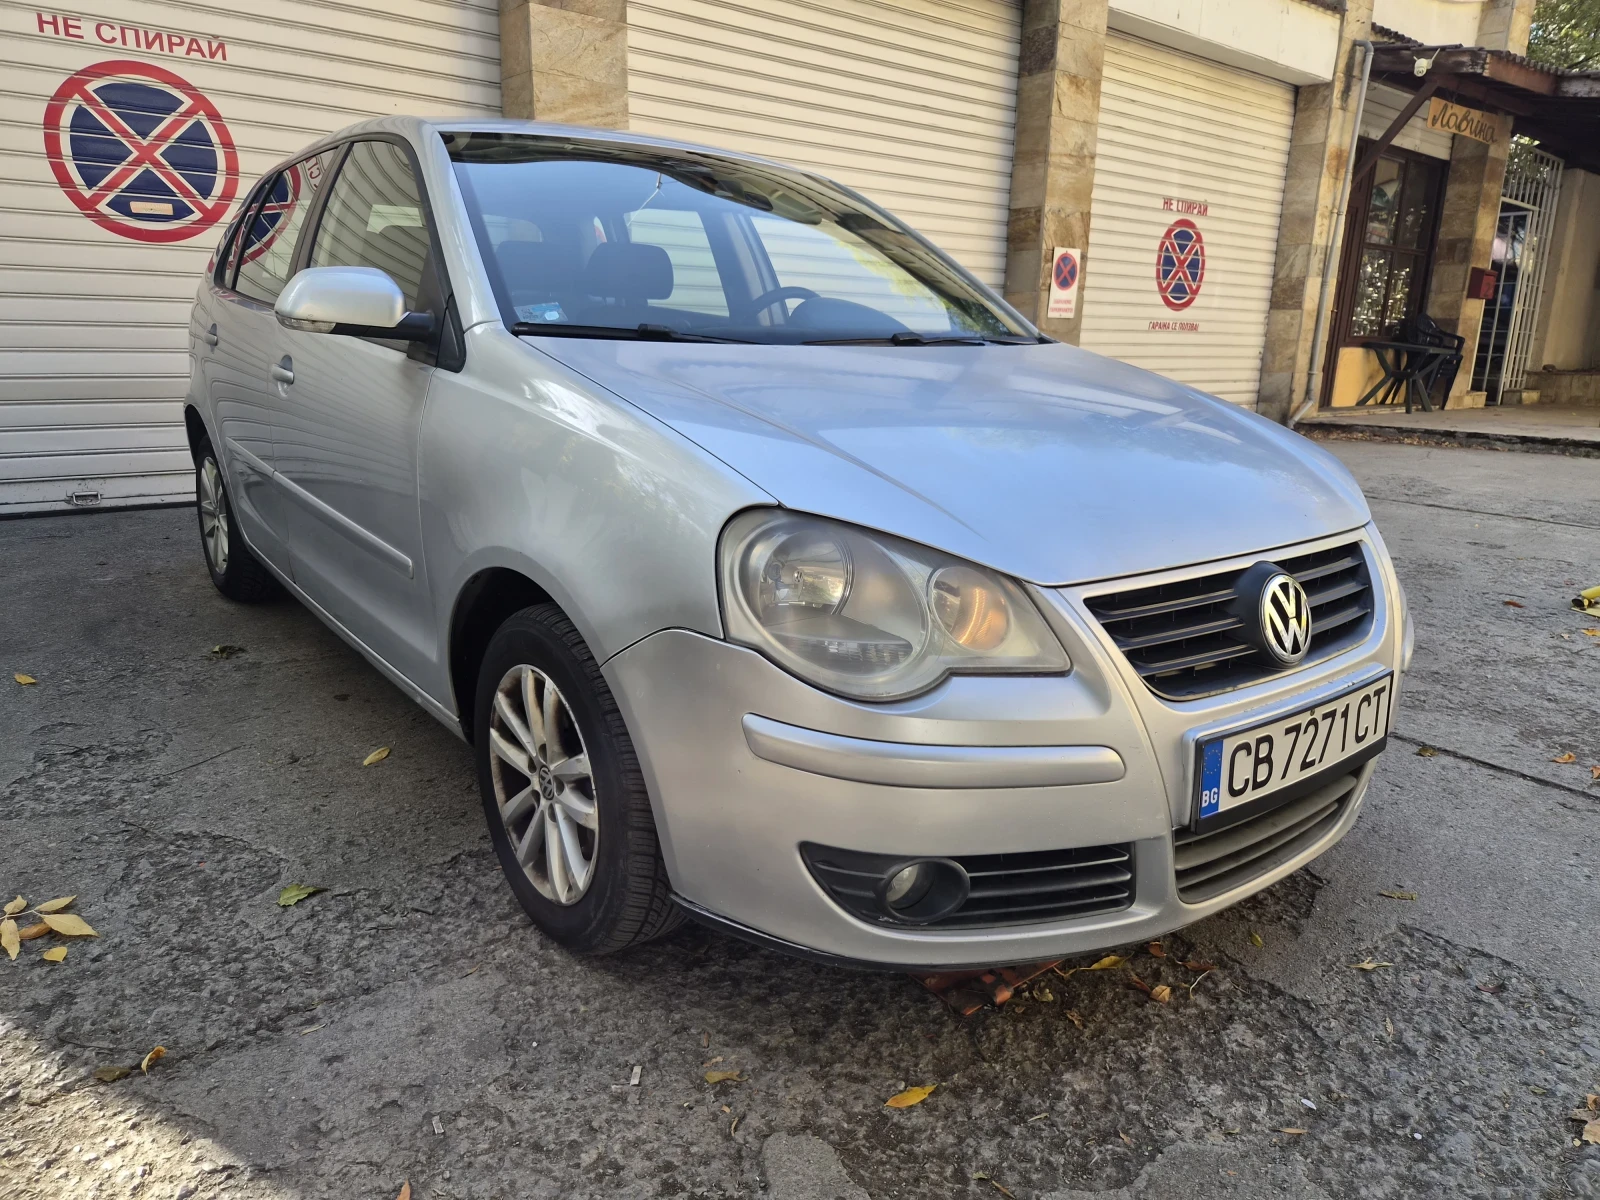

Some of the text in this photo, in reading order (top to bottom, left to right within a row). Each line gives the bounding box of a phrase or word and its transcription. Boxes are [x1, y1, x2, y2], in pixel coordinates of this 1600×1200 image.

[36, 12, 228, 61] НЕ СПИРАЙ
[1162, 197, 1209, 217] НЕ СПИРАЙ
[1280, 702, 1350, 781] 7271
[1201, 787, 1218, 808] BG
